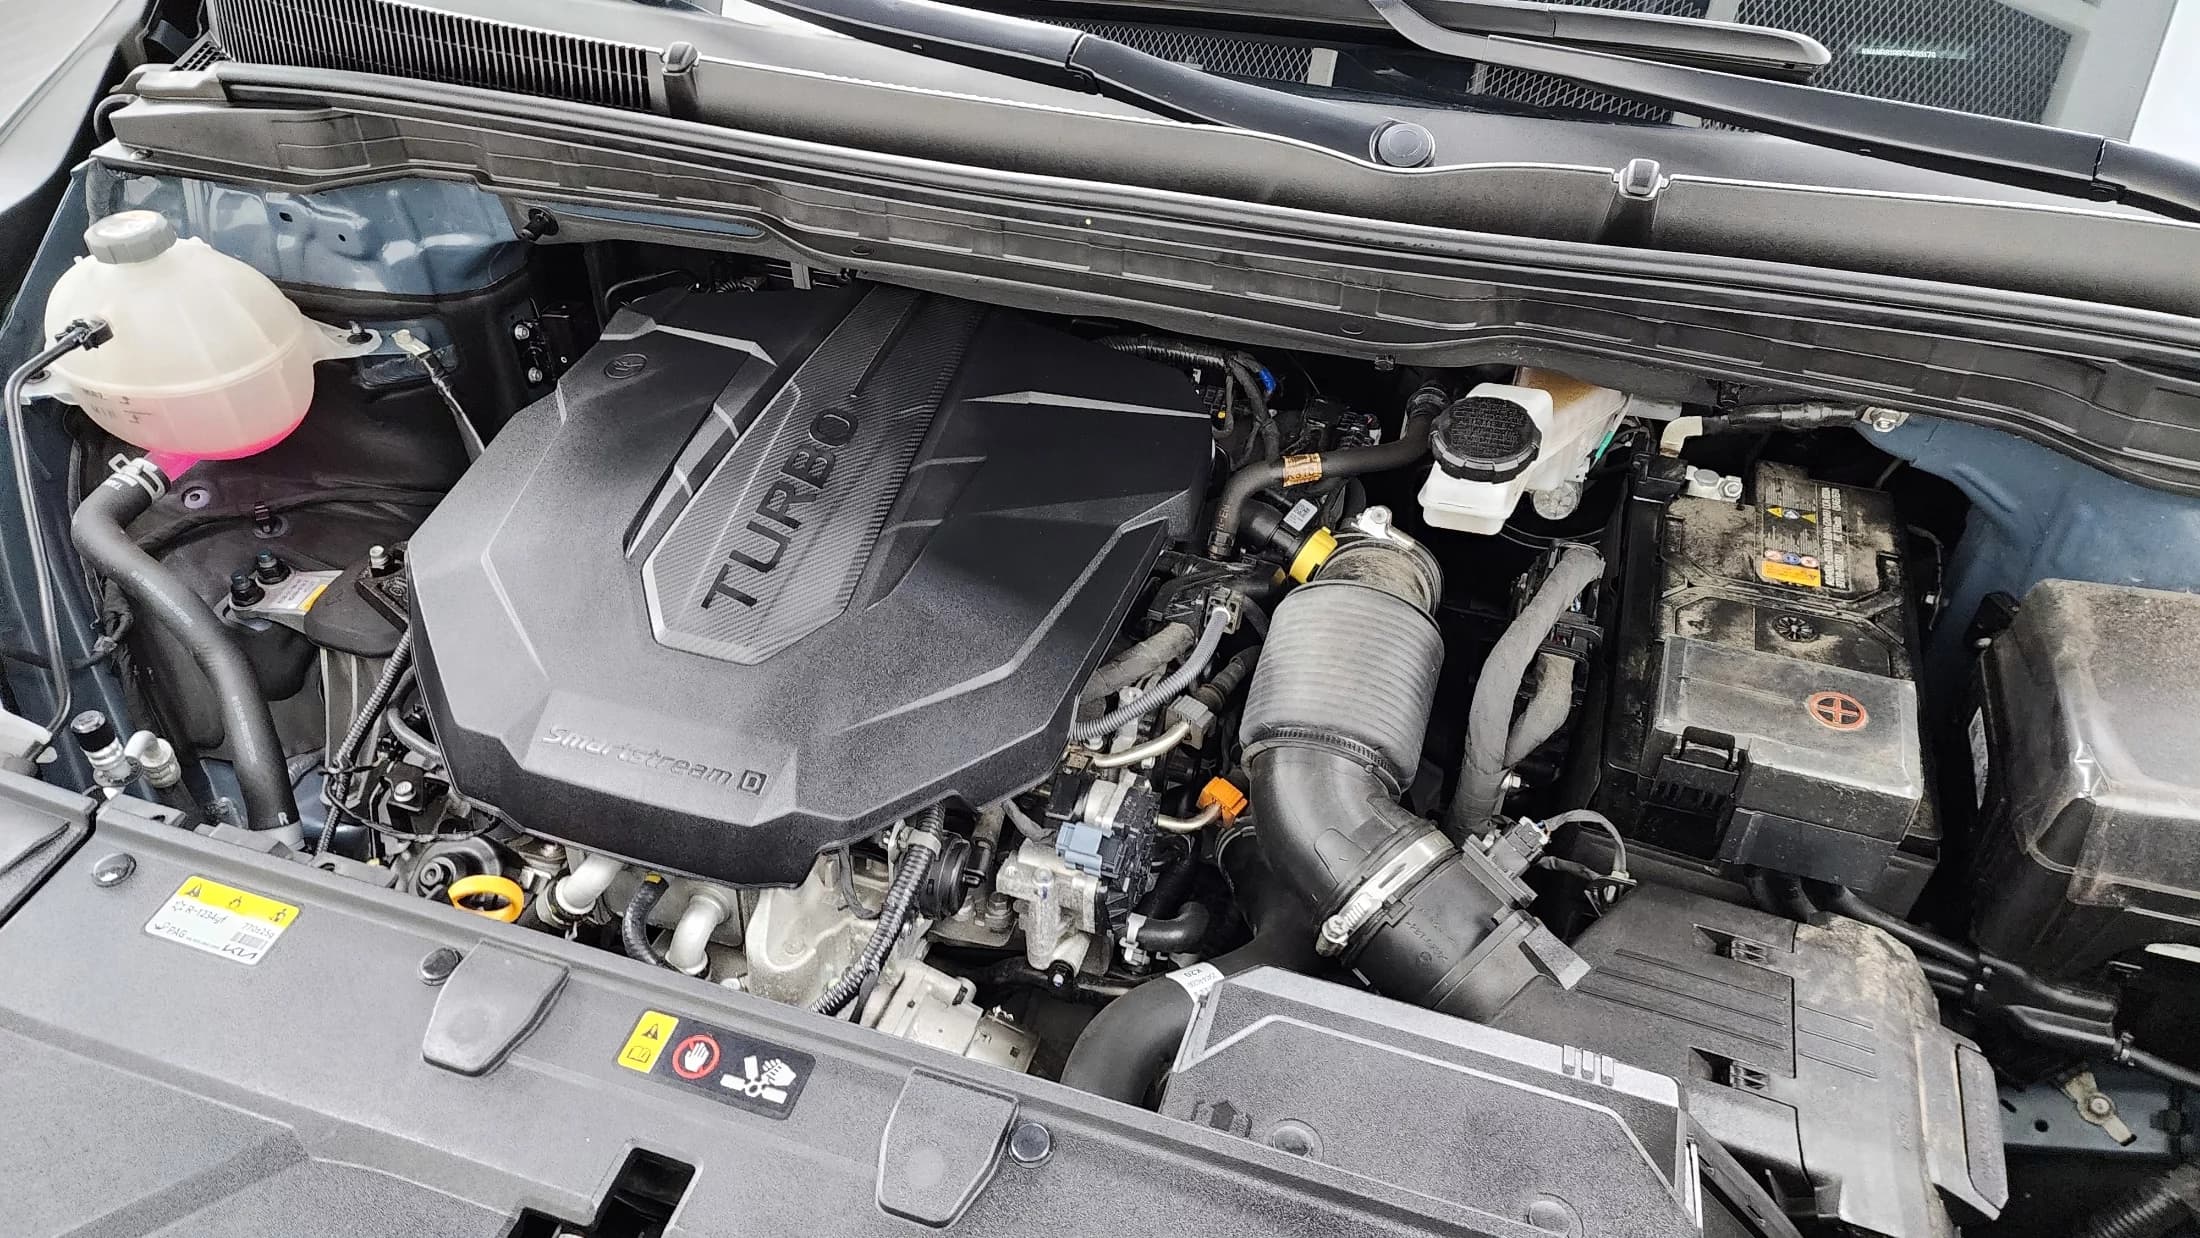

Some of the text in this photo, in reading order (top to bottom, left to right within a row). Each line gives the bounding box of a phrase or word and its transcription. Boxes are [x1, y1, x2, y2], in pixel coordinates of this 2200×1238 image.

[700, 408, 859, 610] TURBO
[541, 725, 735, 786] Smartstream
[278, 812, 290, 826] R
[185, 906, 228, 926] R-1234yf
[168, 925, 187, 939] PAG
